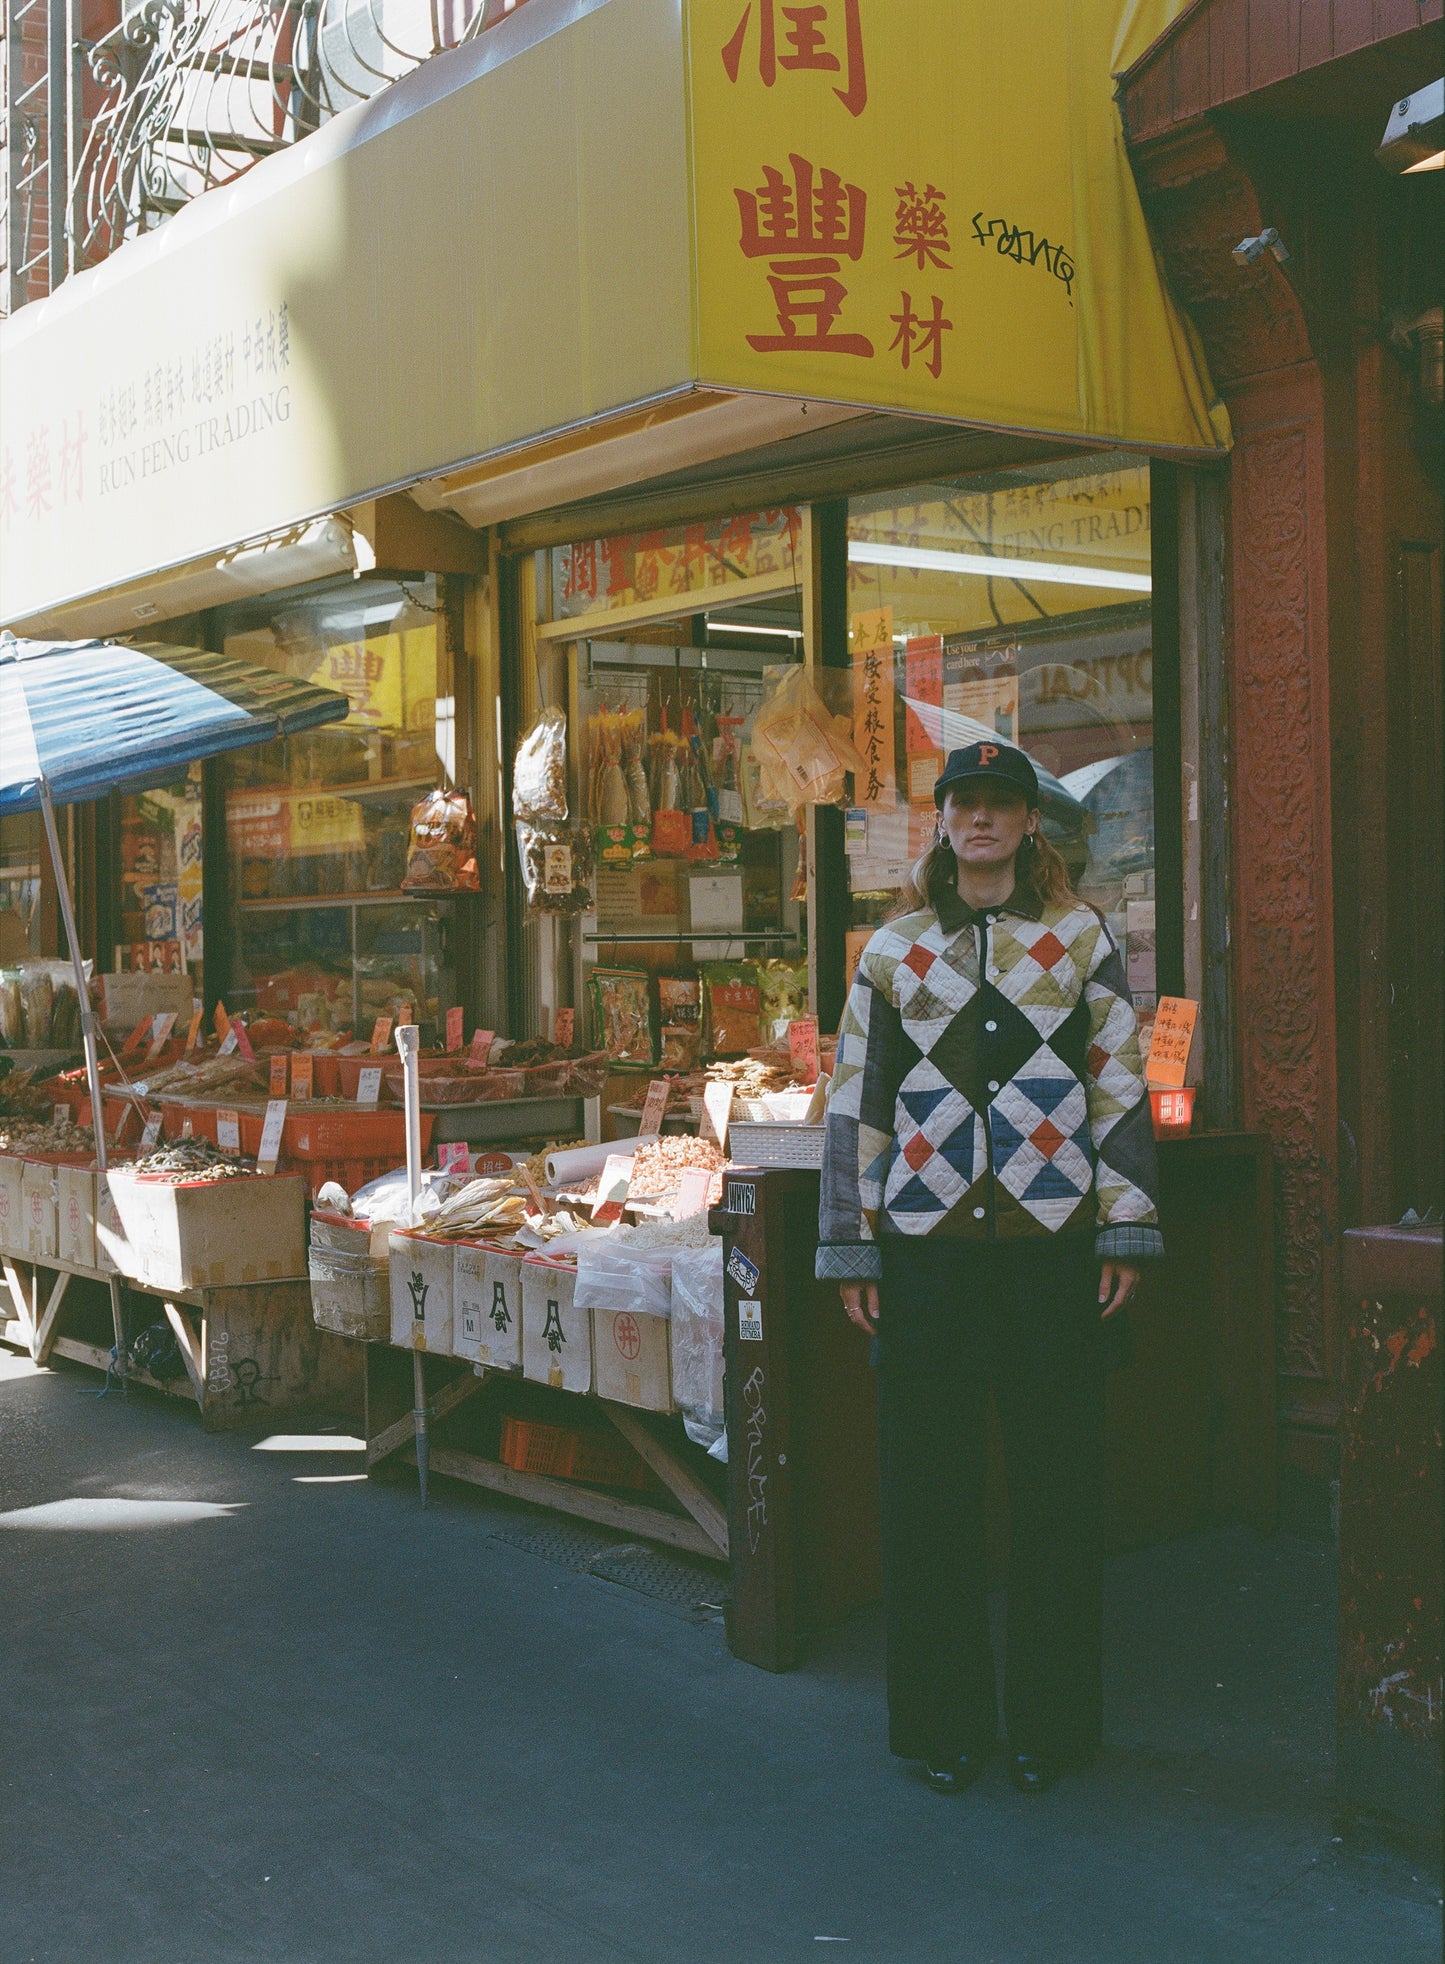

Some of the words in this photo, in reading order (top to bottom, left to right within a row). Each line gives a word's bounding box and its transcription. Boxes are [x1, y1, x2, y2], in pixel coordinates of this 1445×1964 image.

[888, 181, 953, 379] 藥材
[99, 452, 136, 495] RUN
[142, 429, 190, 479] FENG
[197, 385, 291, 456] TRADING
[1002, 522, 1064, 558] FENG
[854, 617, 887, 648] 本店
[946, 658, 964, 670] card
[964, 656, 980, 668] here
[960, 643, 978, 658] your
[979, 745, 999, 766] P
[728, 1182, 755, 1214] WHY62
[466, 1319, 474, 1332] M
